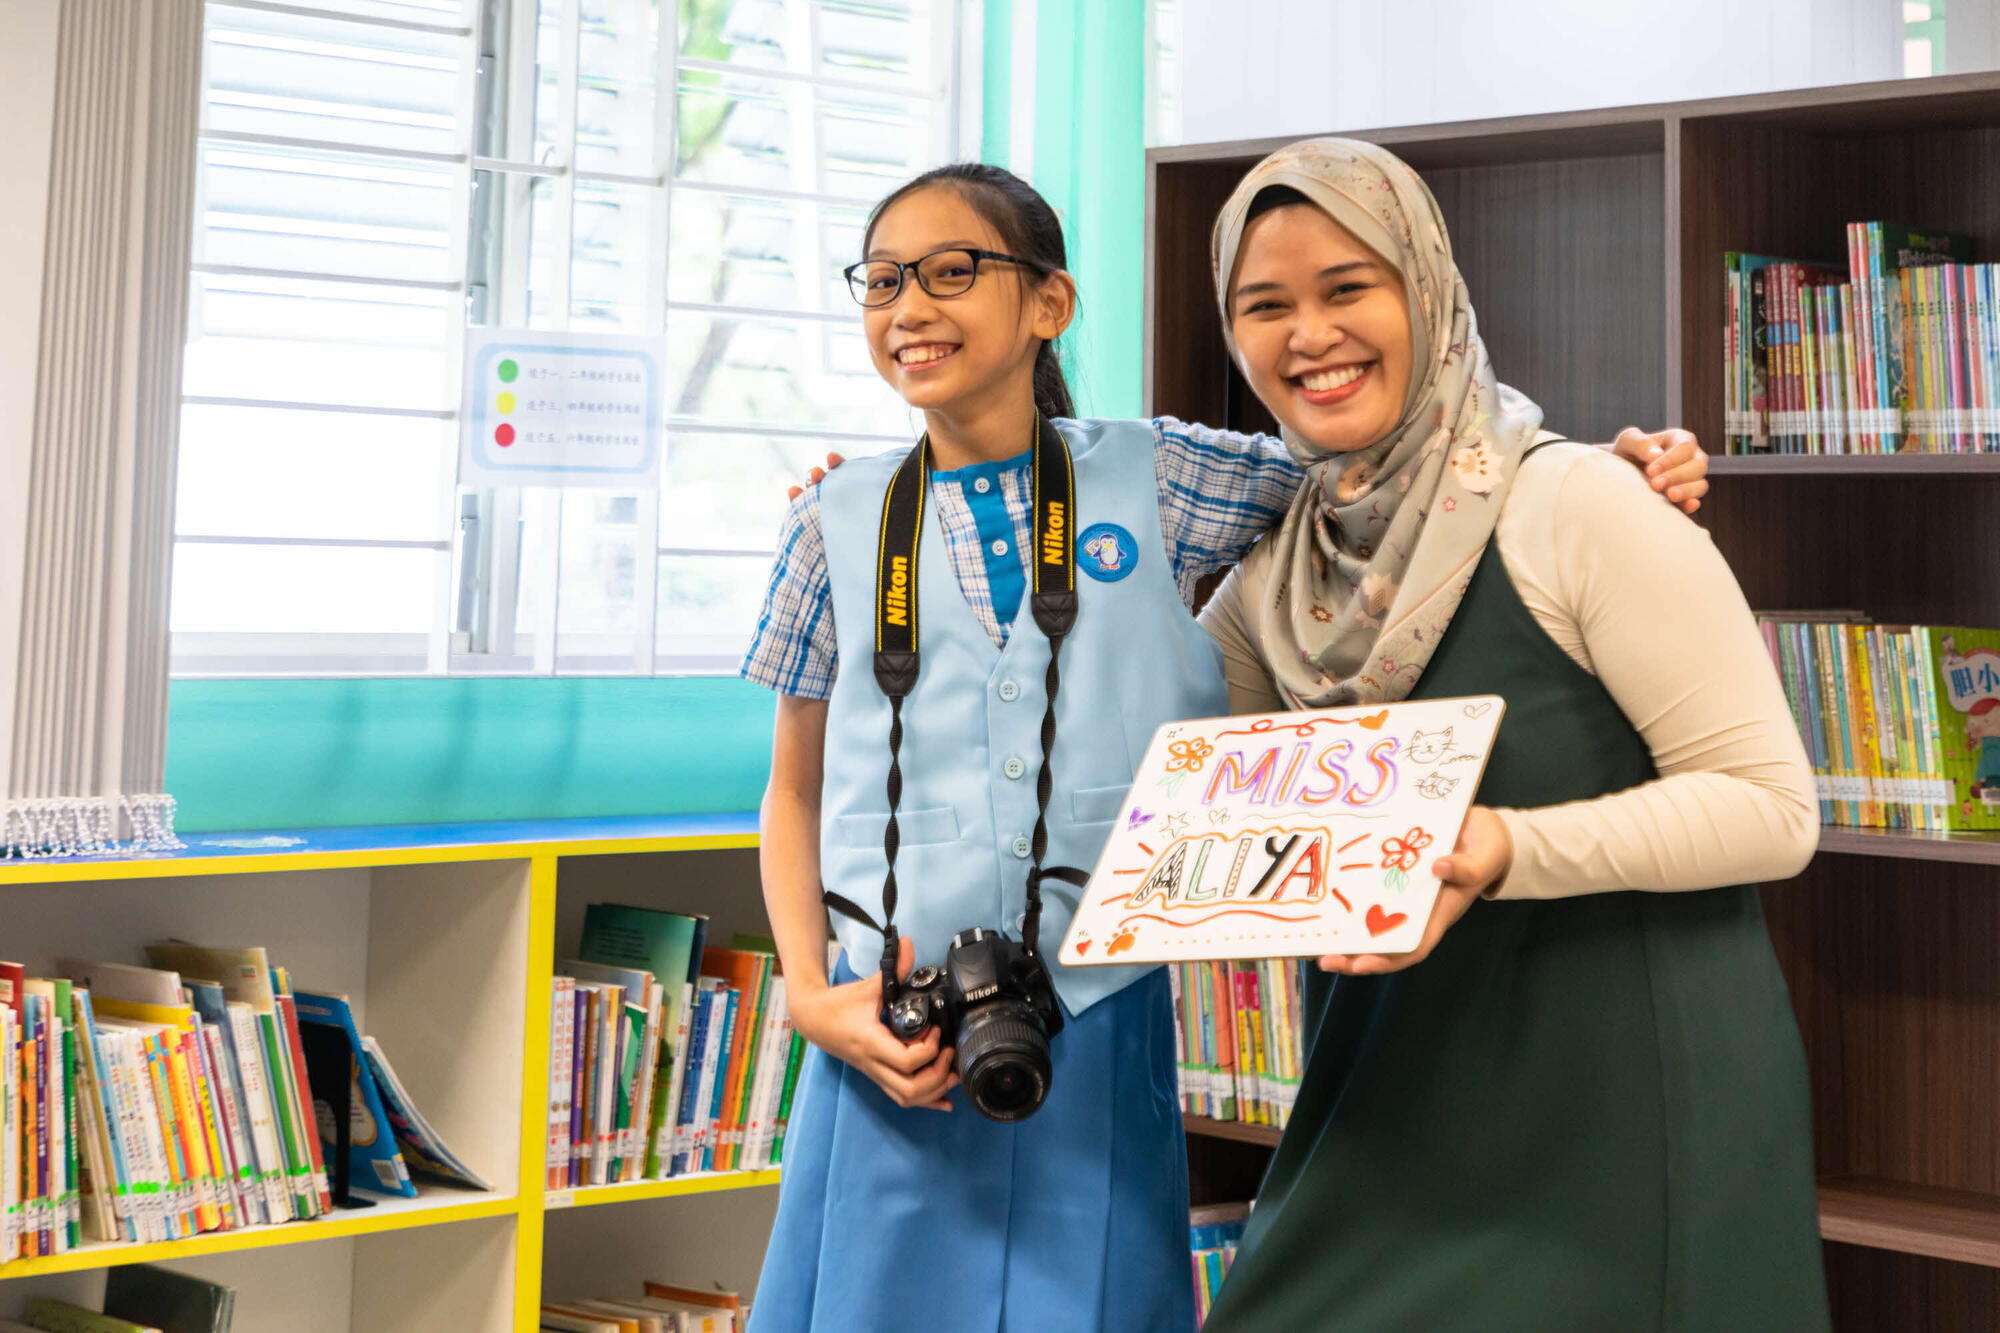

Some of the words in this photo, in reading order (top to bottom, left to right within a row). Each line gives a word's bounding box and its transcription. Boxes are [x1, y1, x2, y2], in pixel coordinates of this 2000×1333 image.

[1044, 501, 1065, 566] Nikon
[887, 555, 908, 627] Nikon
[1202, 736, 1400, 808] MISS
[1135, 834, 1323, 902] ALIYA
[966, 984, 999, 1002] Nikon
